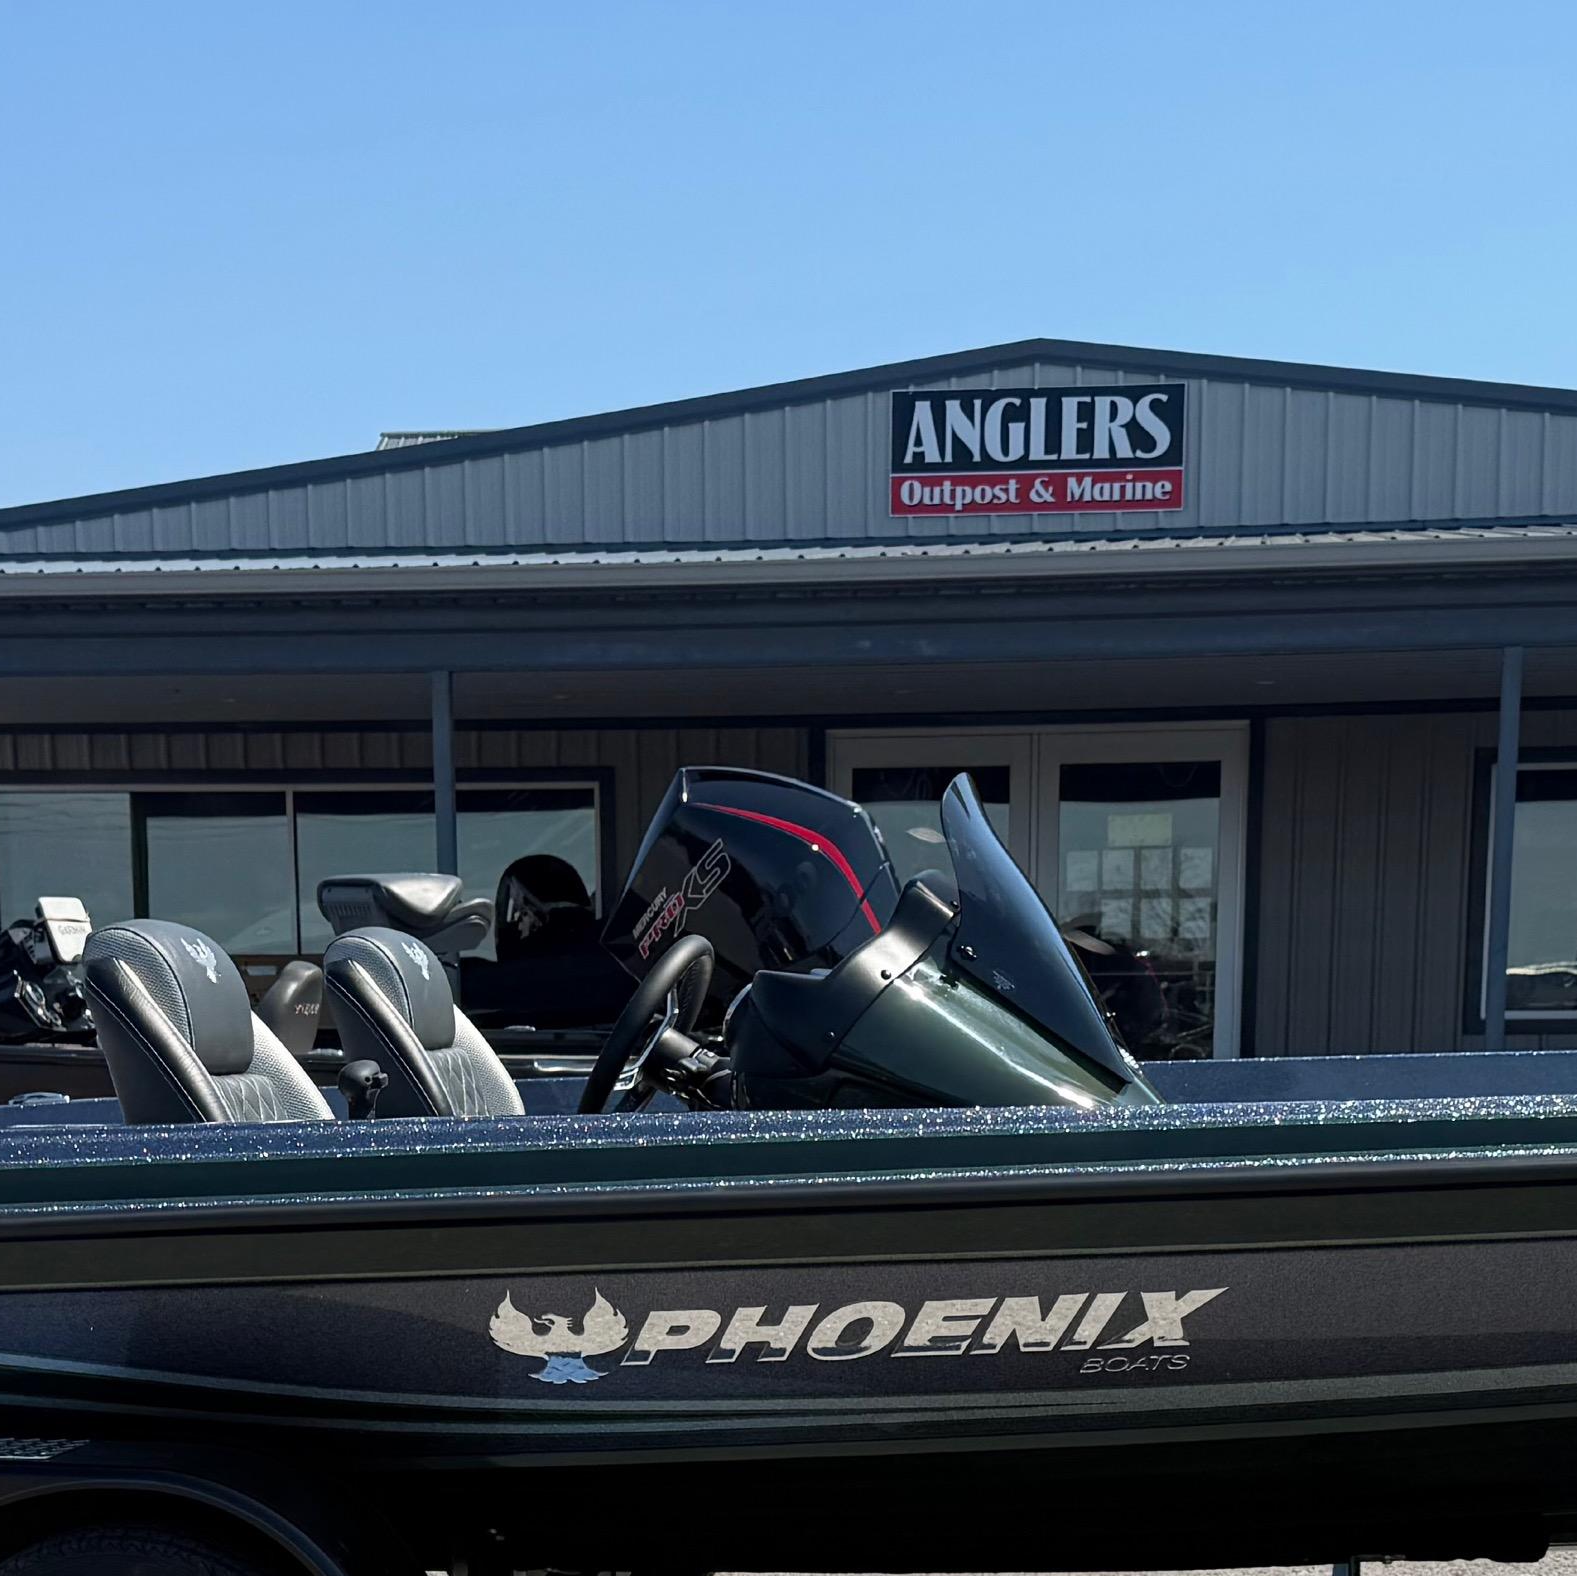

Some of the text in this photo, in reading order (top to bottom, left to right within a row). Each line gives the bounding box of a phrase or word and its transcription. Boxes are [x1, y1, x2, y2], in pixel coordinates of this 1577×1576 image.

[903, 393, 1172, 465] ANGLERS
[900, 474, 1172, 511] Outpost & Marine
[632, 887, 667, 939] MERCURY
[621, 1287, 1228, 1366] PHOENIX
[1080, 1354, 1191, 1373] BOATS
